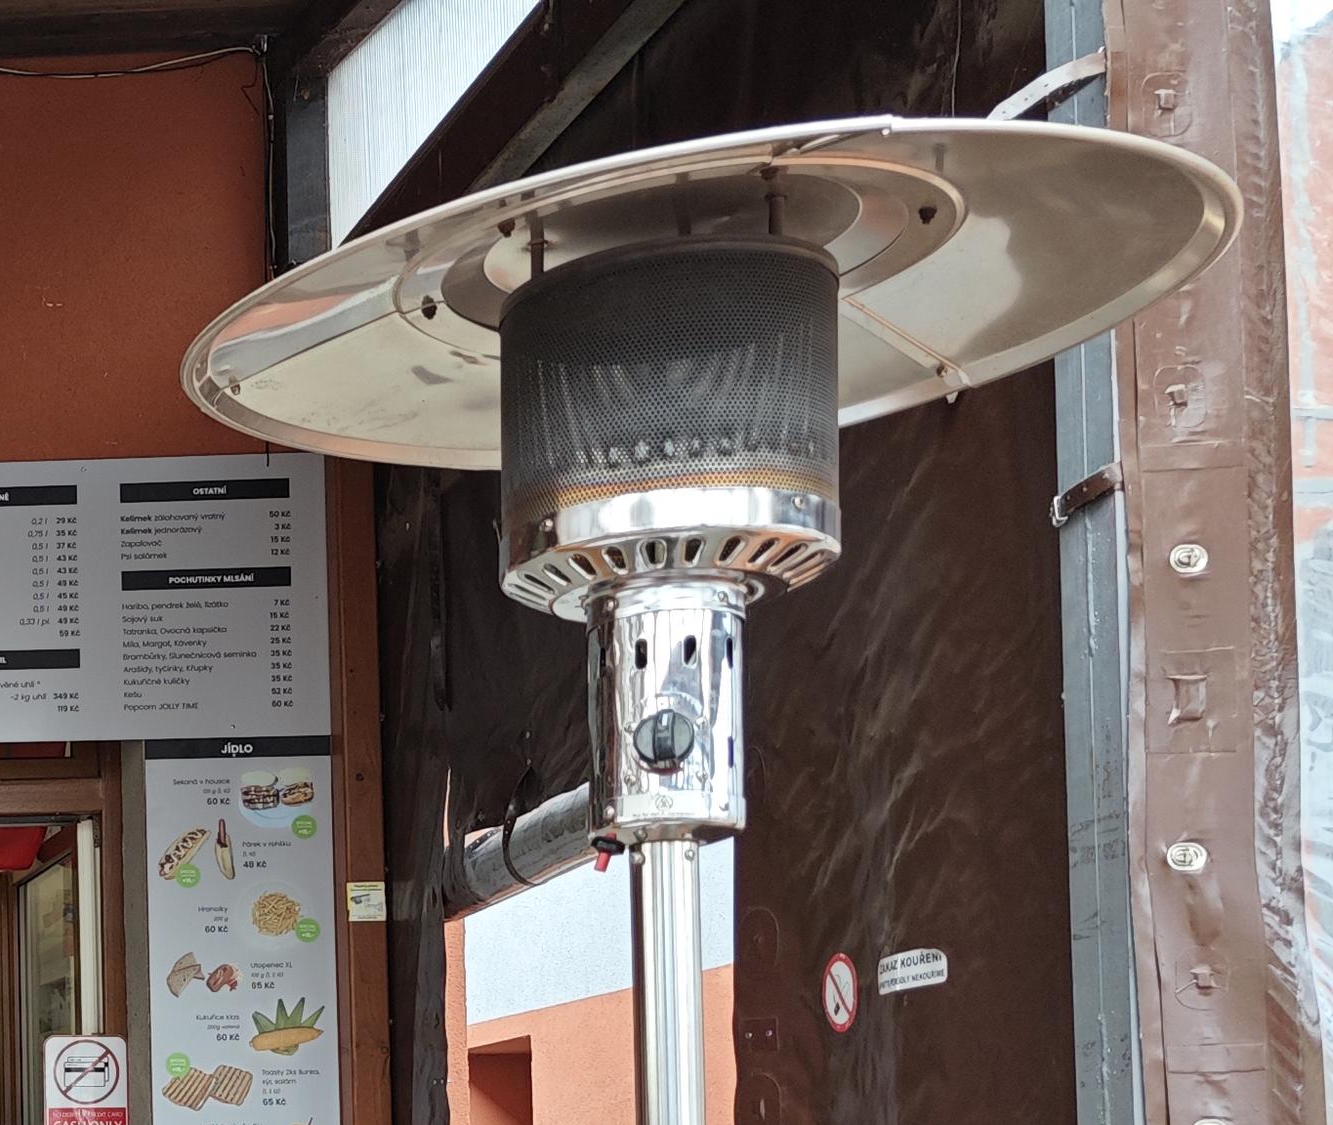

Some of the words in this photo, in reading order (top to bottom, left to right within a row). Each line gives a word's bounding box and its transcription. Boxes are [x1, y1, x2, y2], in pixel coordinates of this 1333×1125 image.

[193, 485, 227, 495] OSTATNÍ
[169, 574, 222, 584] POCHUTINKY
[223, 572, 254, 582] MLSÁNÍ
[221, 742, 253, 754] JÍDLO
[220, 797, 230, 805] Kč
[257, 860, 267, 868] Kč
[901, 952, 942, 968] KOUŘENÍ
